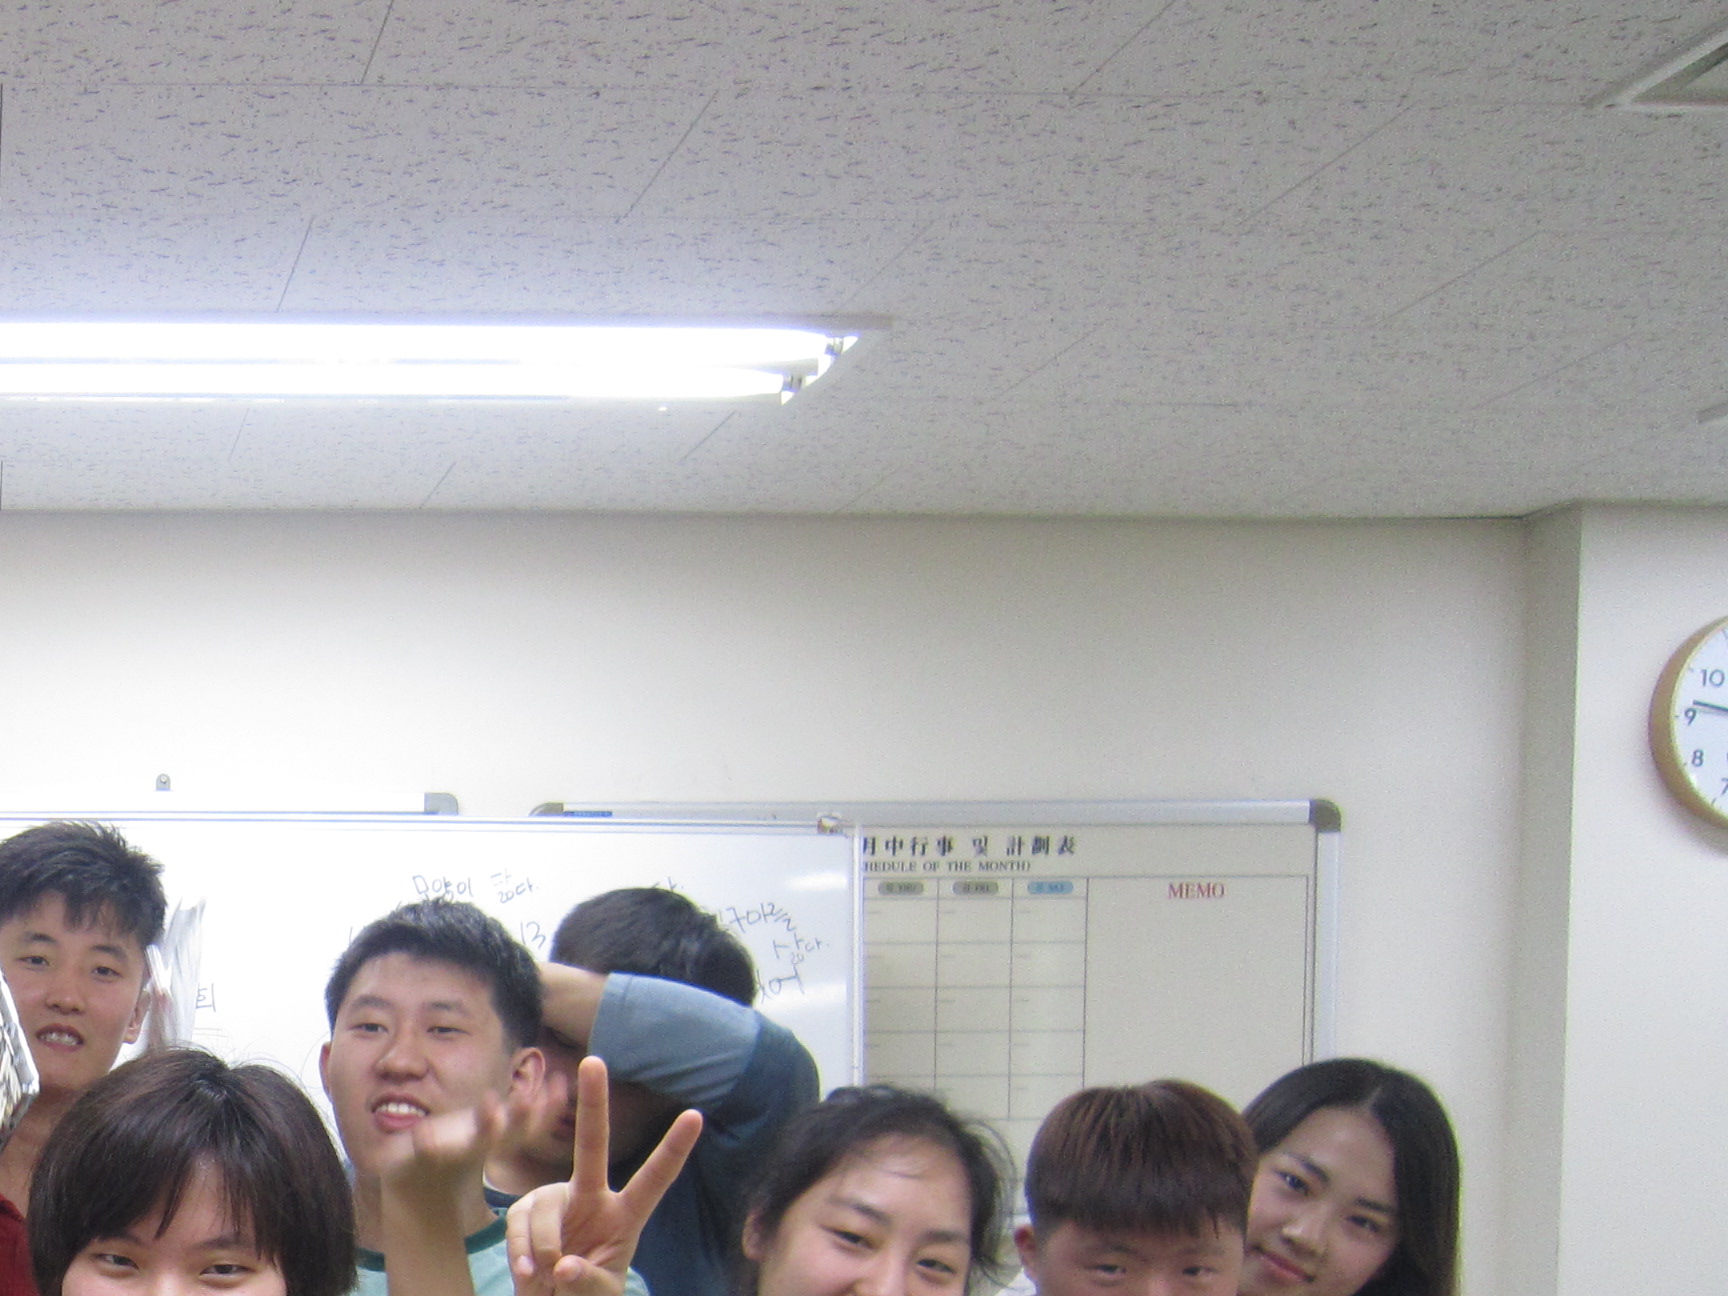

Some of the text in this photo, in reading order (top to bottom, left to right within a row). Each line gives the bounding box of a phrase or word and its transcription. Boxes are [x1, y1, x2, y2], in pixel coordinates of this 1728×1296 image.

[1701, 669, 1725, 687] 10
[1684, 708, 1697, 726] 9
[1691, 749, 1704, 767] 8
[863, 860, 917, 872] HEDULE
[923, 860, 940, 872] OF
[947, 860, 971, 872] THE
[1167, 882, 1225, 899] MEMO
